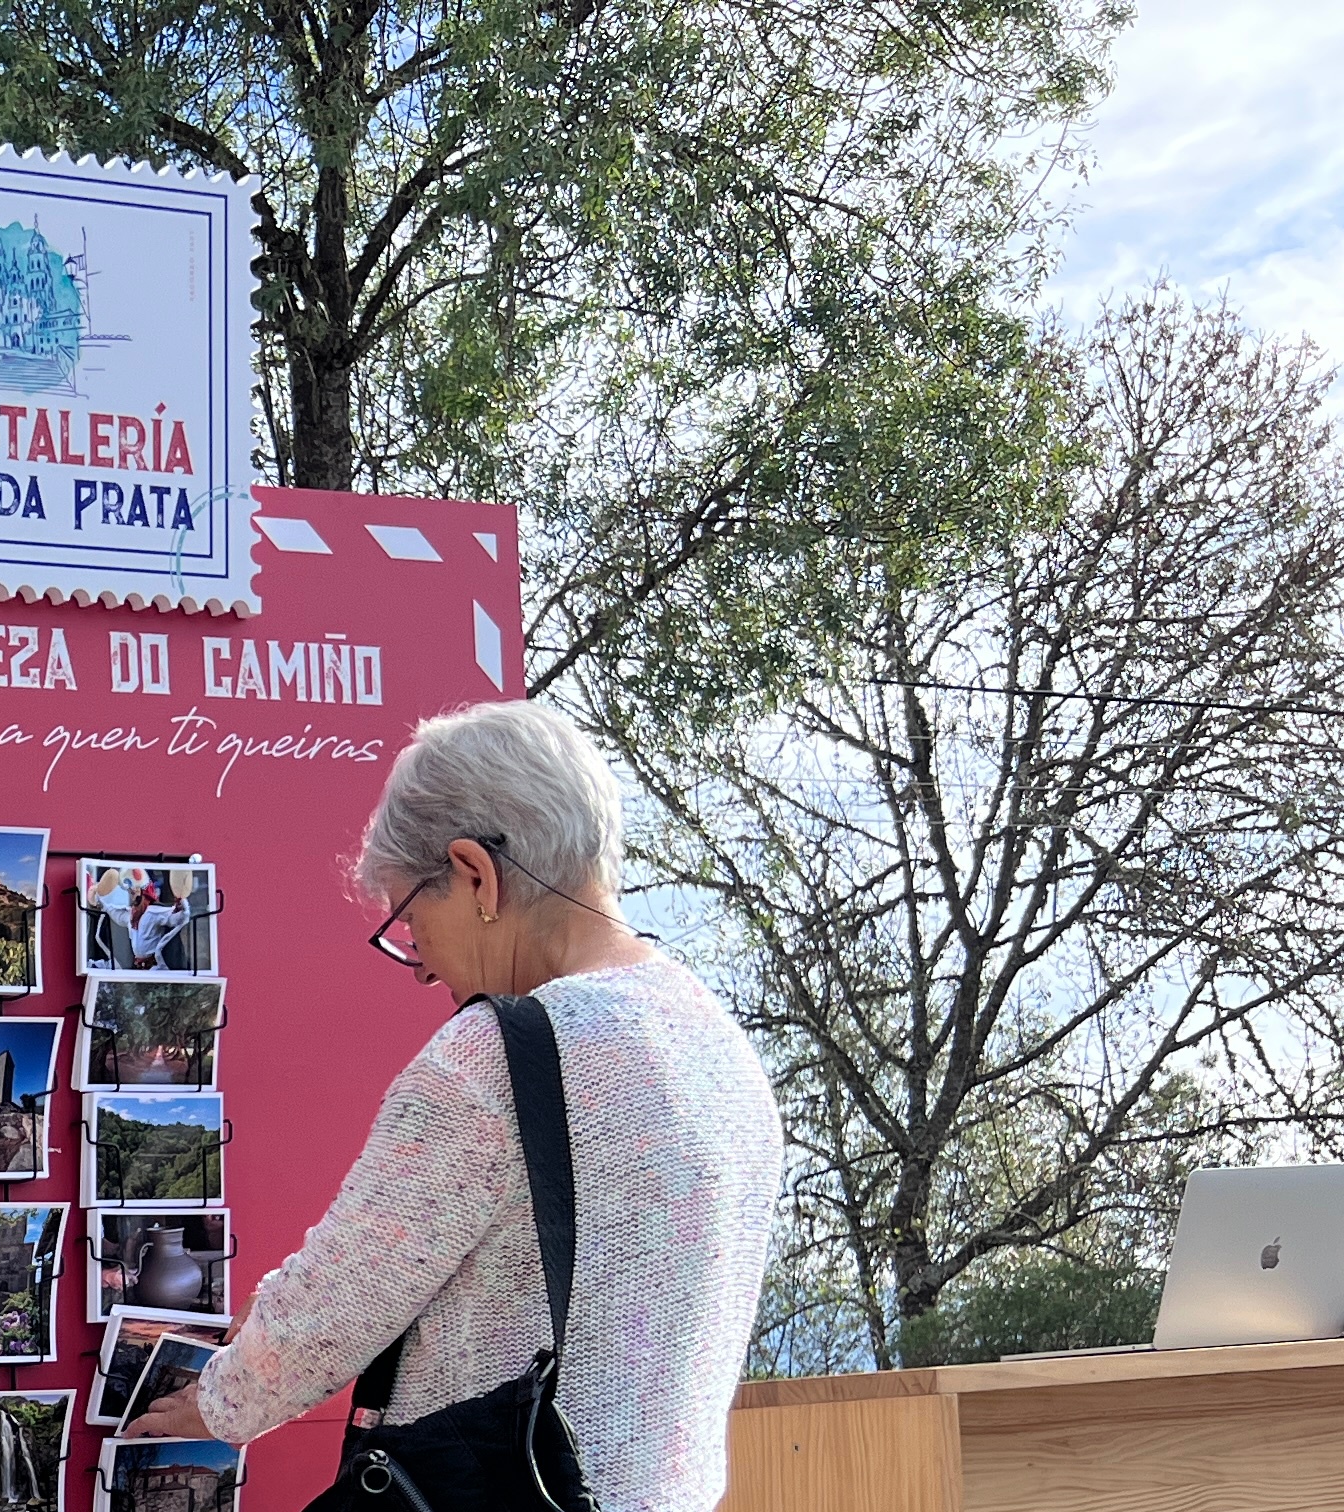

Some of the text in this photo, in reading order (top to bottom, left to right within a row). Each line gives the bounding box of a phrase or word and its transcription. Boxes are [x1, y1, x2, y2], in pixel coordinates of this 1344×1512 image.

[74, 478, 195, 531] PRATA
[110, 631, 171, 695] DO
[201, 633, 383, 706] CAMIÑO
[43, 725, 160, 792] quen
[166, 707, 217, 755] ti
[216, 723, 384, 798] queiras
